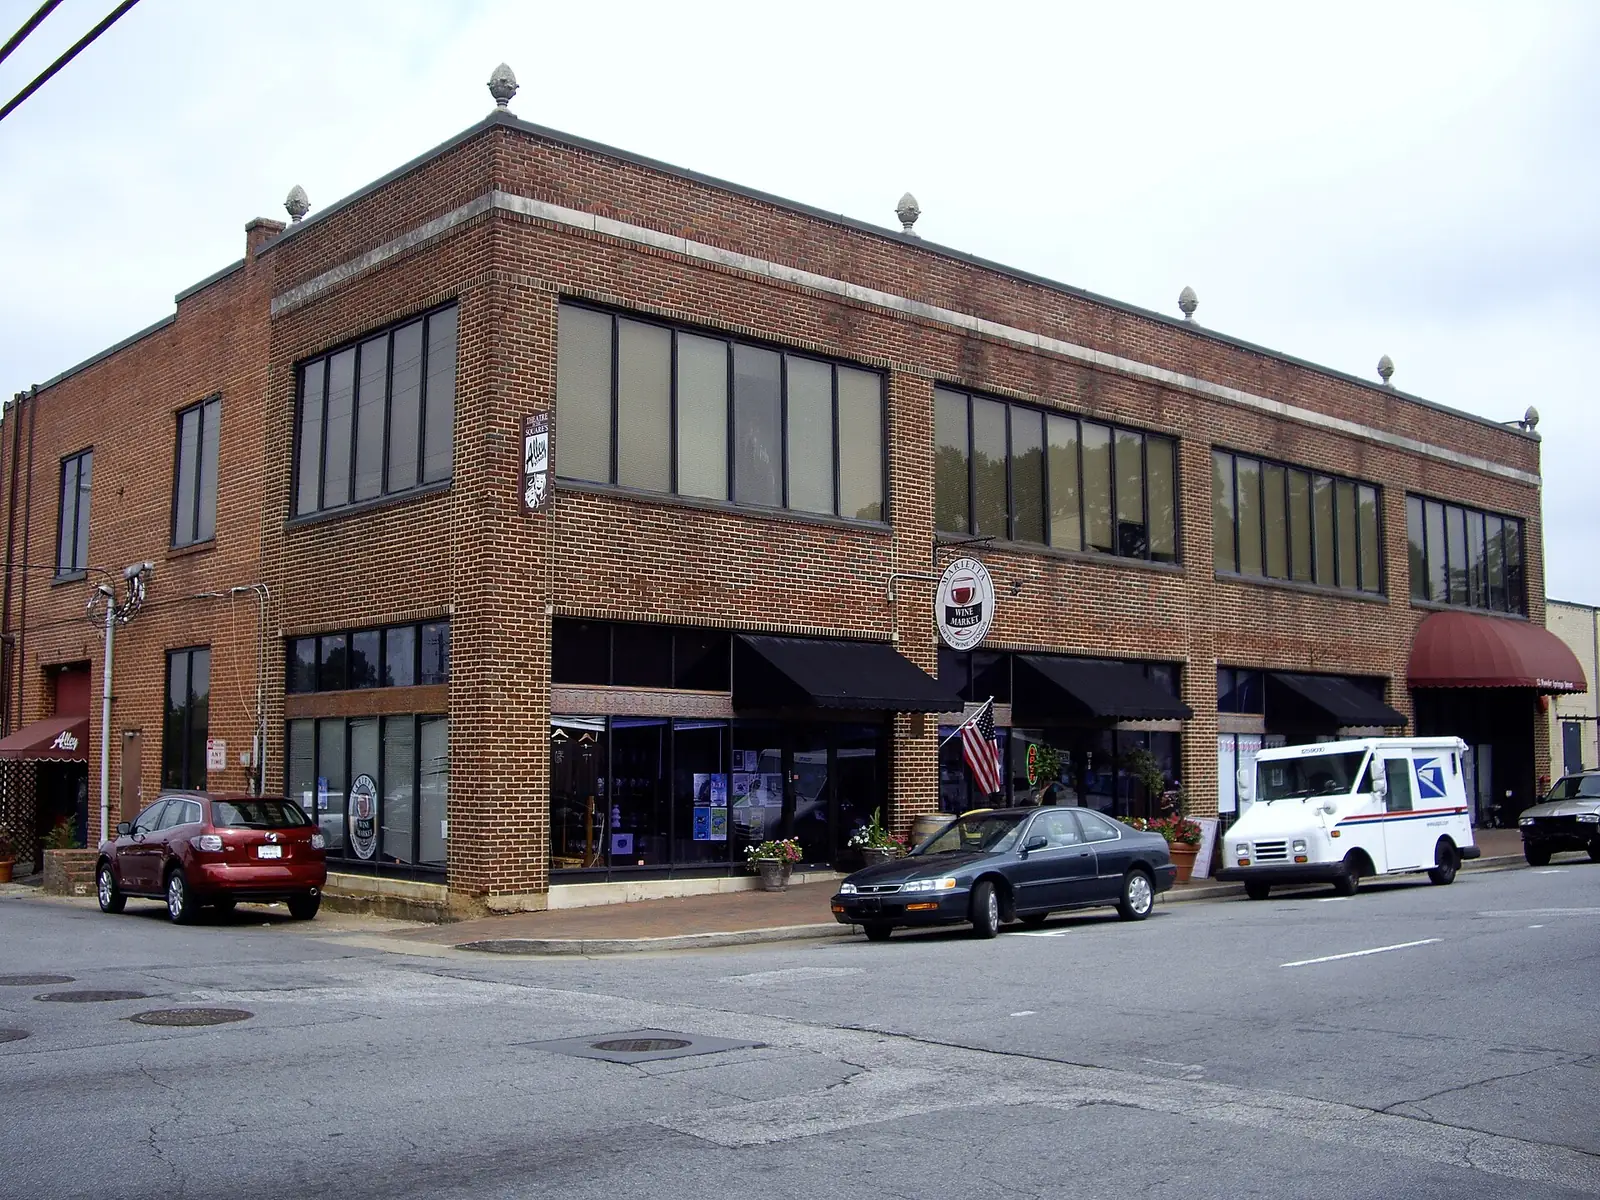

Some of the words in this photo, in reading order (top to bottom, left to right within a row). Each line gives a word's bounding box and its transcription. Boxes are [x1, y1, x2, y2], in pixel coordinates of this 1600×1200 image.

[526, 412, 549, 425] THEATRE
[525, 437, 547, 474] Alley
[941, 560, 987, 586] MARIETTA
[950, 615, 980, 626] MARKET
[955, 607, 974, 617] WINE
[973, 621, 987, 643] FOODS
[49, 731, 78, 750] Alley
